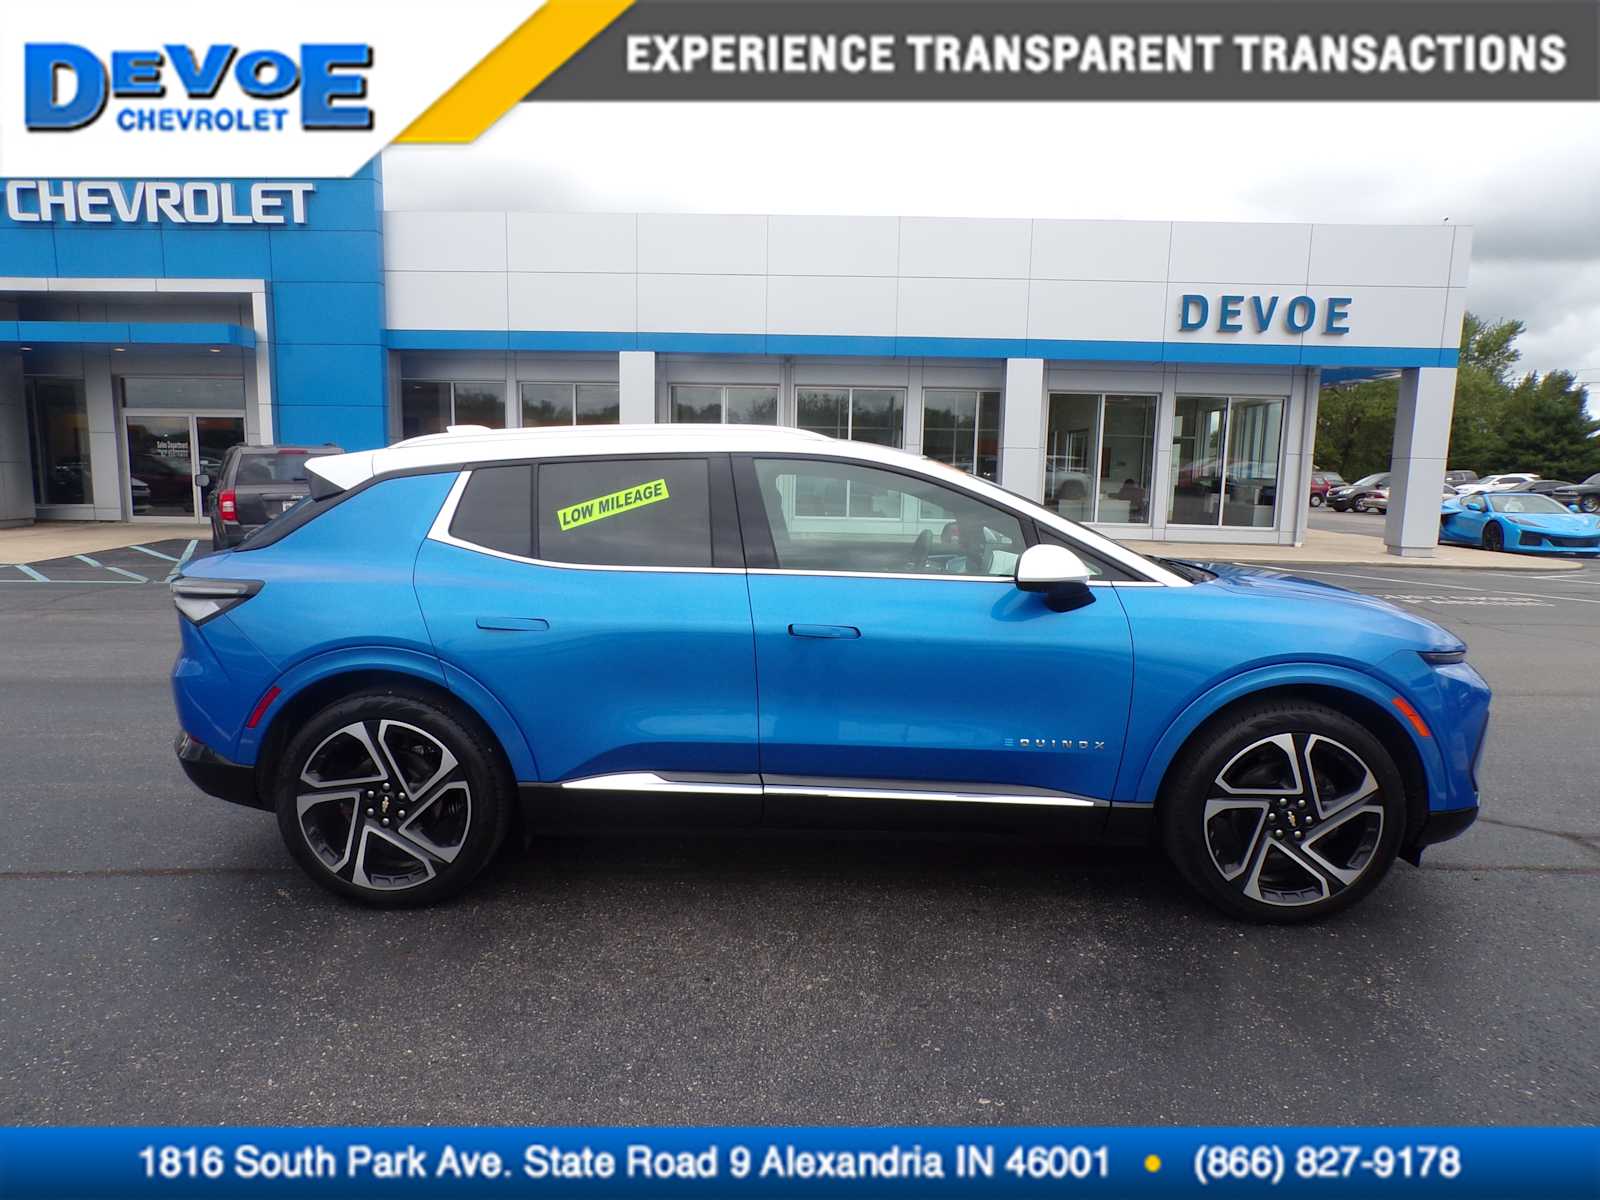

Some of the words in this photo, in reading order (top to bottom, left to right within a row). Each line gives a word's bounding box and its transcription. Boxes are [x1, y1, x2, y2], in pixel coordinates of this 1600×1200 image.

[6, 180, 315, 225] CHEVROLET
[1179, 294, 1353, 336] DEVOE
[562, 503, 594, 526] LOW
[598, 482, 663, 515] MILEAGE
[1004, 738, 1105, 750] EQUINOX
